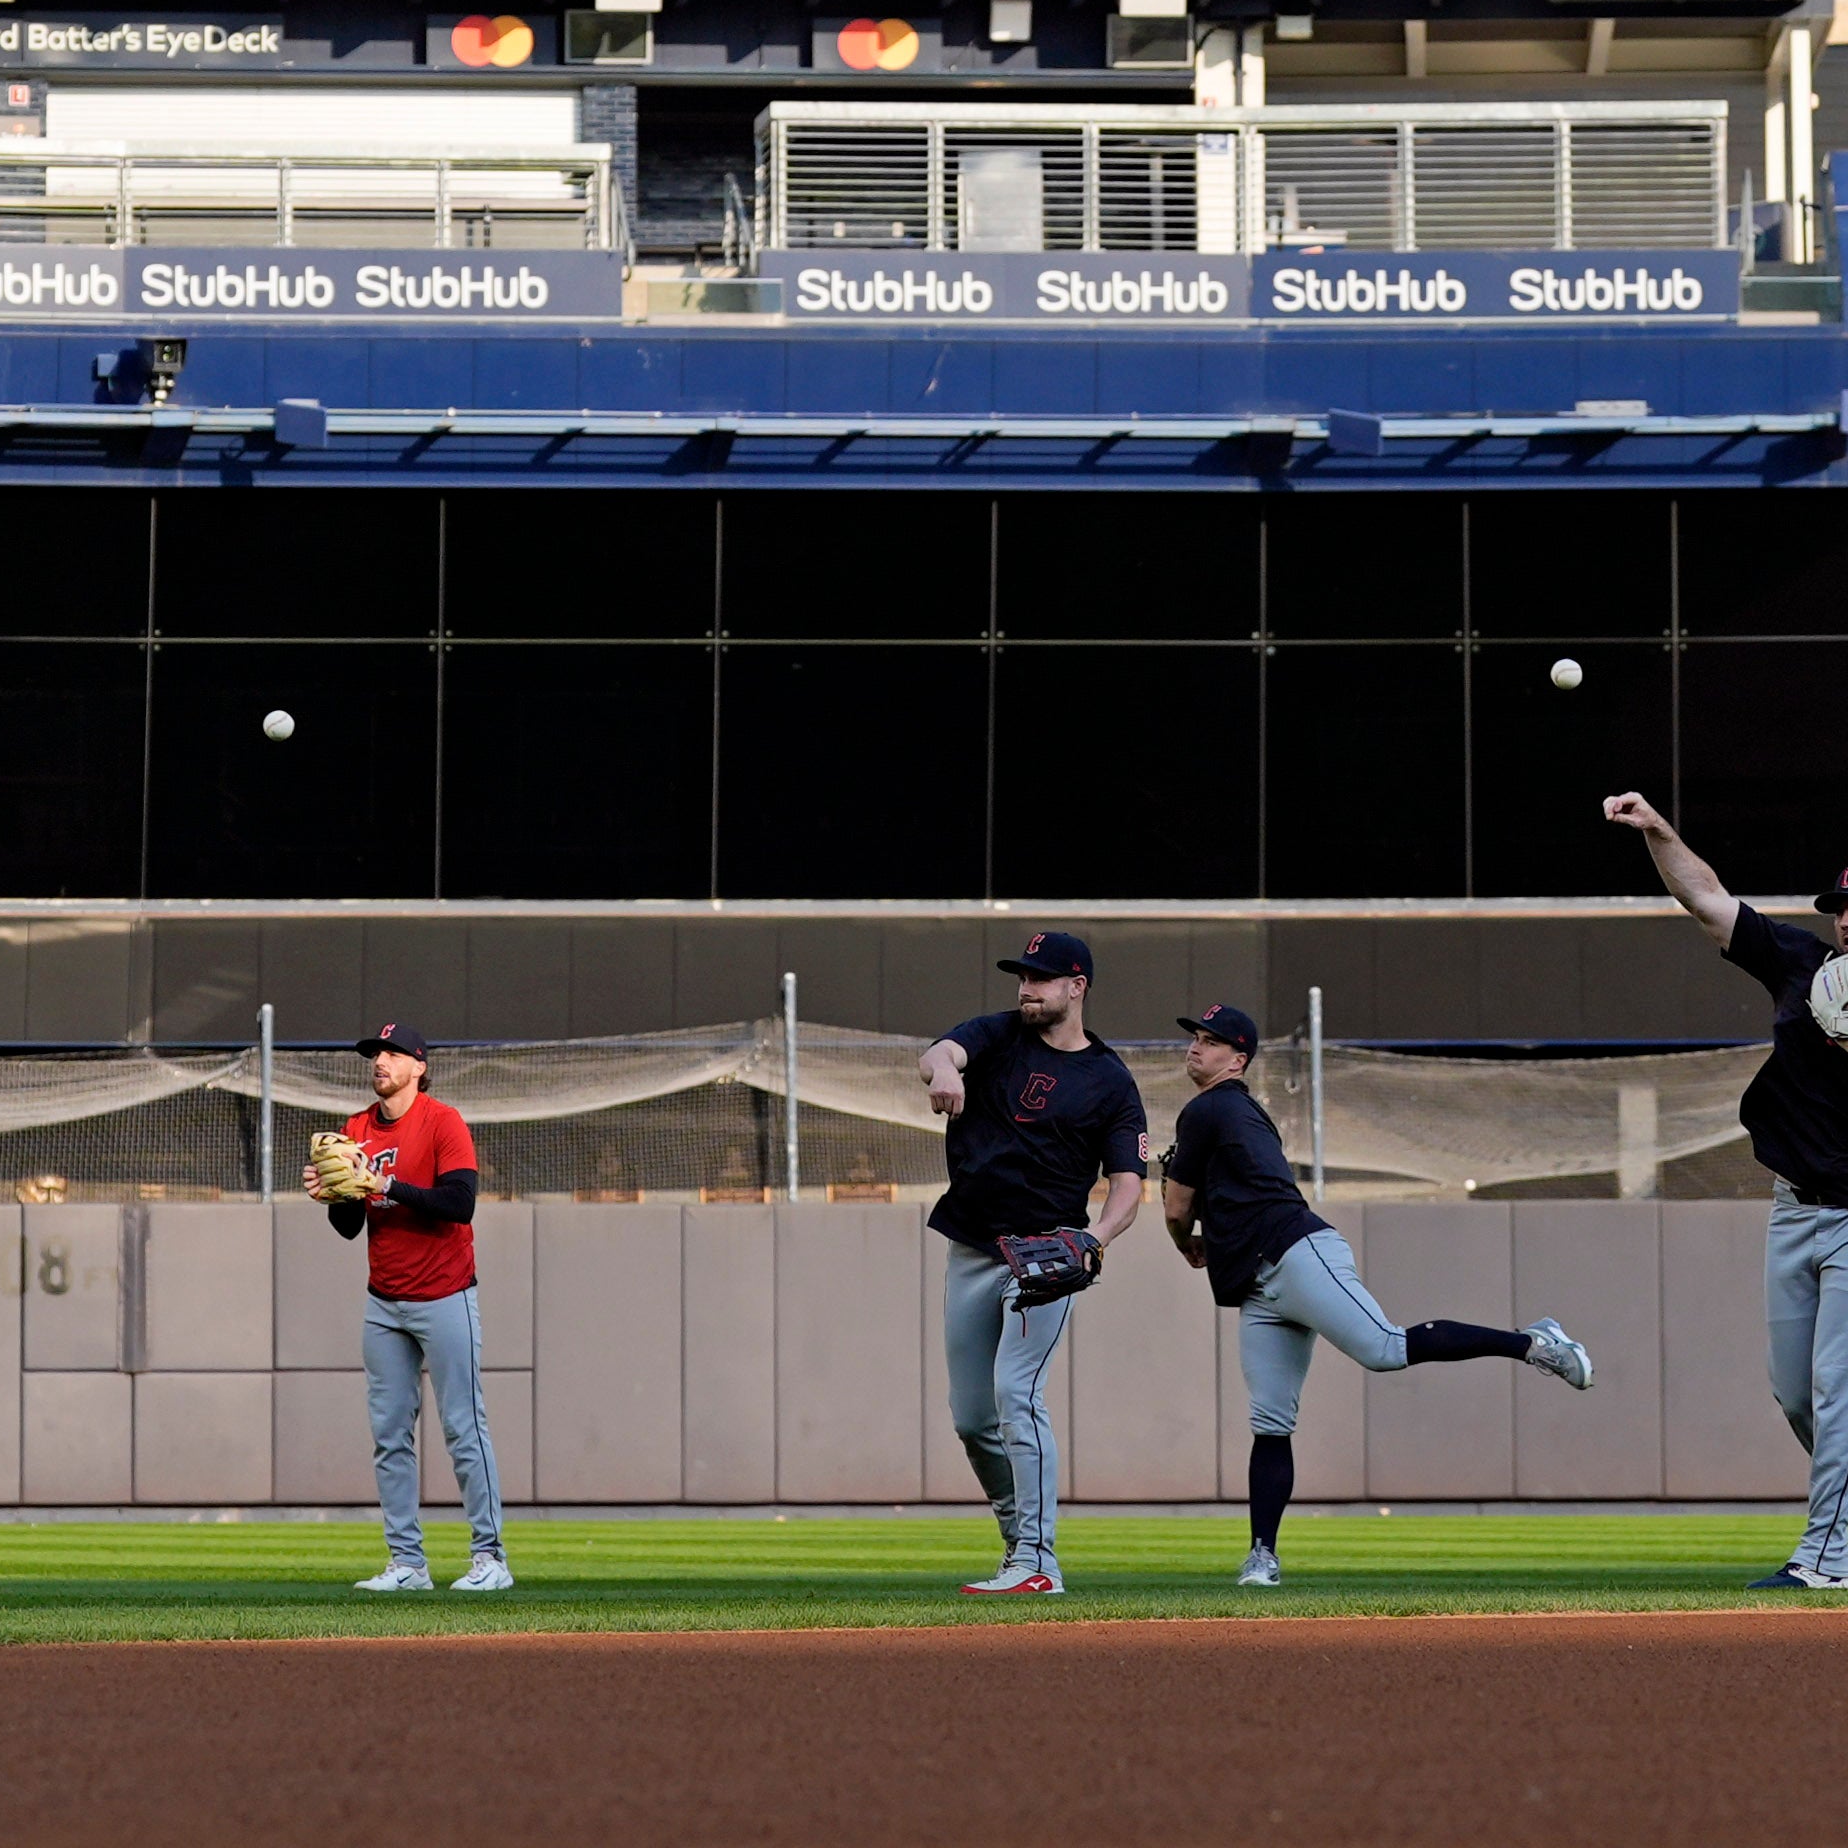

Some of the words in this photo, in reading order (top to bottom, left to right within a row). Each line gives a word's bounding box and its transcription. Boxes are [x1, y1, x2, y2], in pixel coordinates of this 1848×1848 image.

[28, 23, 142, 52] Batter's
[146, 23, 201, 59] Eye
[204, 24, 280, 53] Deck
[141, 263, 335, 309] StubHub
[355, 265, 549, 310] StubHub
[796, 268, 993, 314] StubHub
[1036, 270, 1229, 315] StubHub
[1271, 268, 1467, 313] StubHub
[1508, 268, 1703, 313] StubHub
